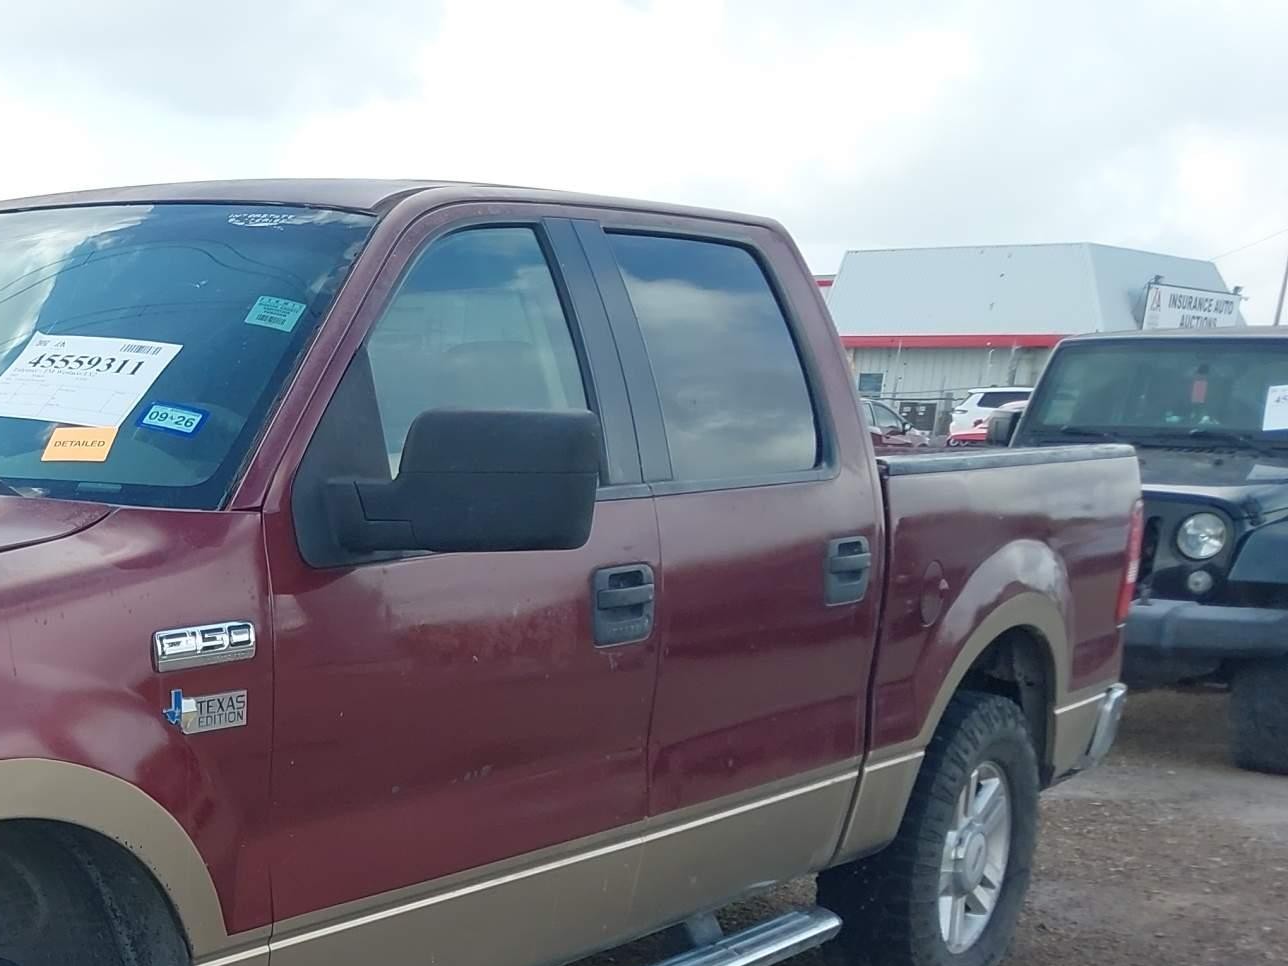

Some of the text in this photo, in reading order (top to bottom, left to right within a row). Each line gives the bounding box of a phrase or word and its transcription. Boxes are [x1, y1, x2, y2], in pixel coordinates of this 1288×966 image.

[1168, 293, 1214, 313] INSURANCE
[1214, 300, 1234, 315] AUTO
[1179, 314, 1218, 329] AUCTIONS
[28, 352, 145, 376] 45559311
[148, 410, 196, 428] 09 26
[54, 439, 106, 448] DETAILED
[197, 694, 246, 716] TEXAS
[198, 710, 244, 728] EDITION
